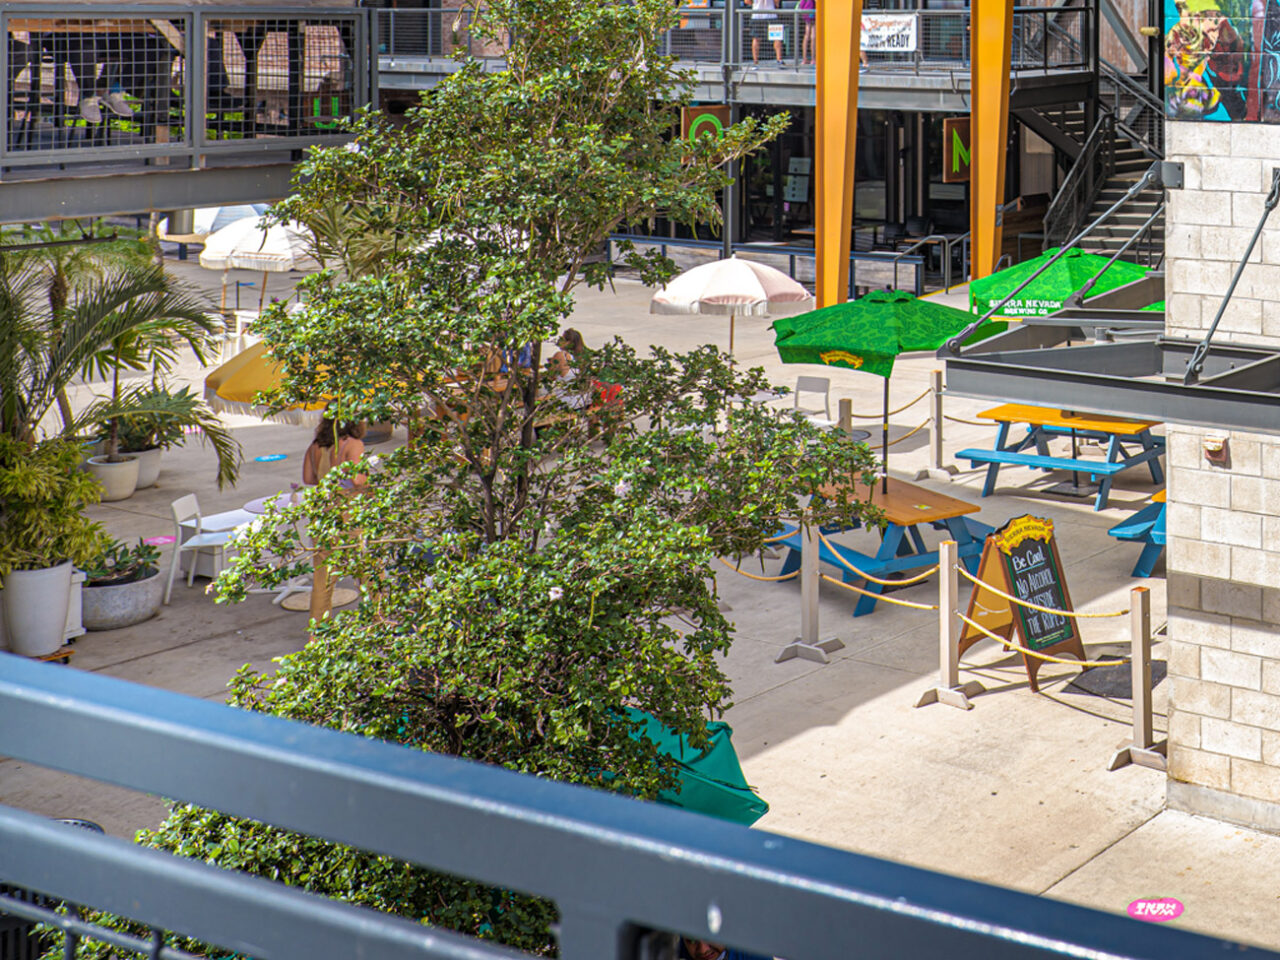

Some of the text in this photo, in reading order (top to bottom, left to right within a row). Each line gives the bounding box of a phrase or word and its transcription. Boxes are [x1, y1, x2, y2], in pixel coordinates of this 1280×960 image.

[886, 33, 910, 48] READY
[989, 299, 1061, 309] SIRRA NEVADA
[1012, 545, 1047, 571] Be Cool
[1028, 568, 1056, 592] ALCOHOL
